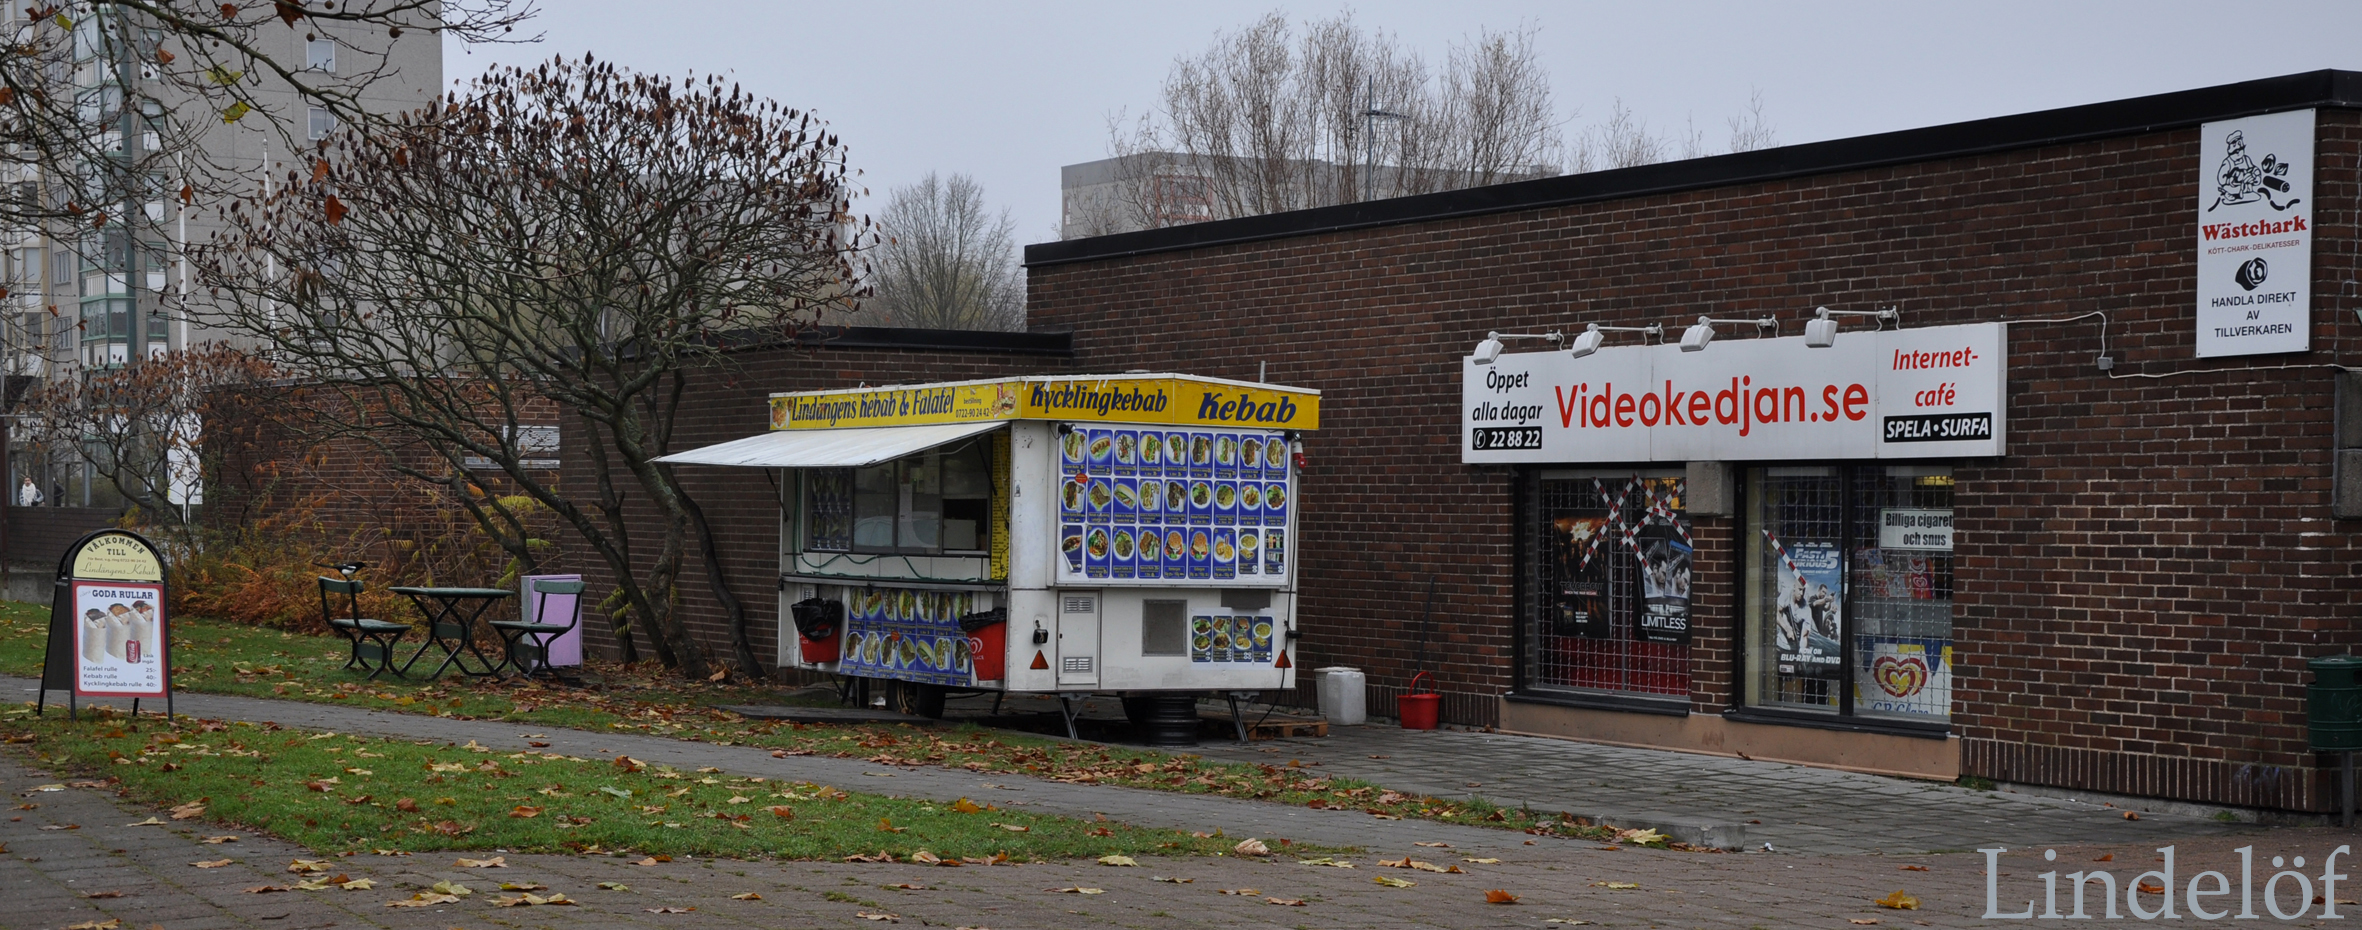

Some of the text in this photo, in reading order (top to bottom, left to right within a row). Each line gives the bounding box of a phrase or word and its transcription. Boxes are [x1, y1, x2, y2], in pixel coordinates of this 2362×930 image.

[2201, 215, 2307, 241] Wästchark
[2211, 291, 2297, 308] HANDLA DIREKT
[2246, 309, 2260, 320] AV
[2214, 323, 2292, 338] TILLVERKAREN
[1892, 346, 1979, 370] Internet-
[1486, 366, 1529, 394] Öppet
[859, 392, 896, 418] Kebab
[899, 392, 910, 416] &
[912, 387, 956, 416] Falafel
[1030, 383, 1297, 423] Kycklingkebab Kebab
[1914, 382, 1956, 407] café
[955, 407, 990, 418] 0722-90 24 42
[1472, 400, 1543, 425] alla dagar
[1555, 375, 1869, 437] Videokedjan.se
[1489, 429, 1540, 447] 22 88 22
[1885, 513, 1916, 528] Billiga
[87, 536, 145, 554] VÄLKOMMEN
[1903, 532, 1947, 546] och snus
[107, 548, 126, 556] TILL
[1794, 548, 1821, 559] FAST
[1826, 550, 1840, 569] 5
[127, 564, 156, 576] Kebab
[92, 589, 117, 598] GODA
[119, 590, 154, 600] RULLAR
[1641, 615, 1687, 631] LIMITLESS
[1780, 653, 1841, 665] BLU-RAY AND DVD
